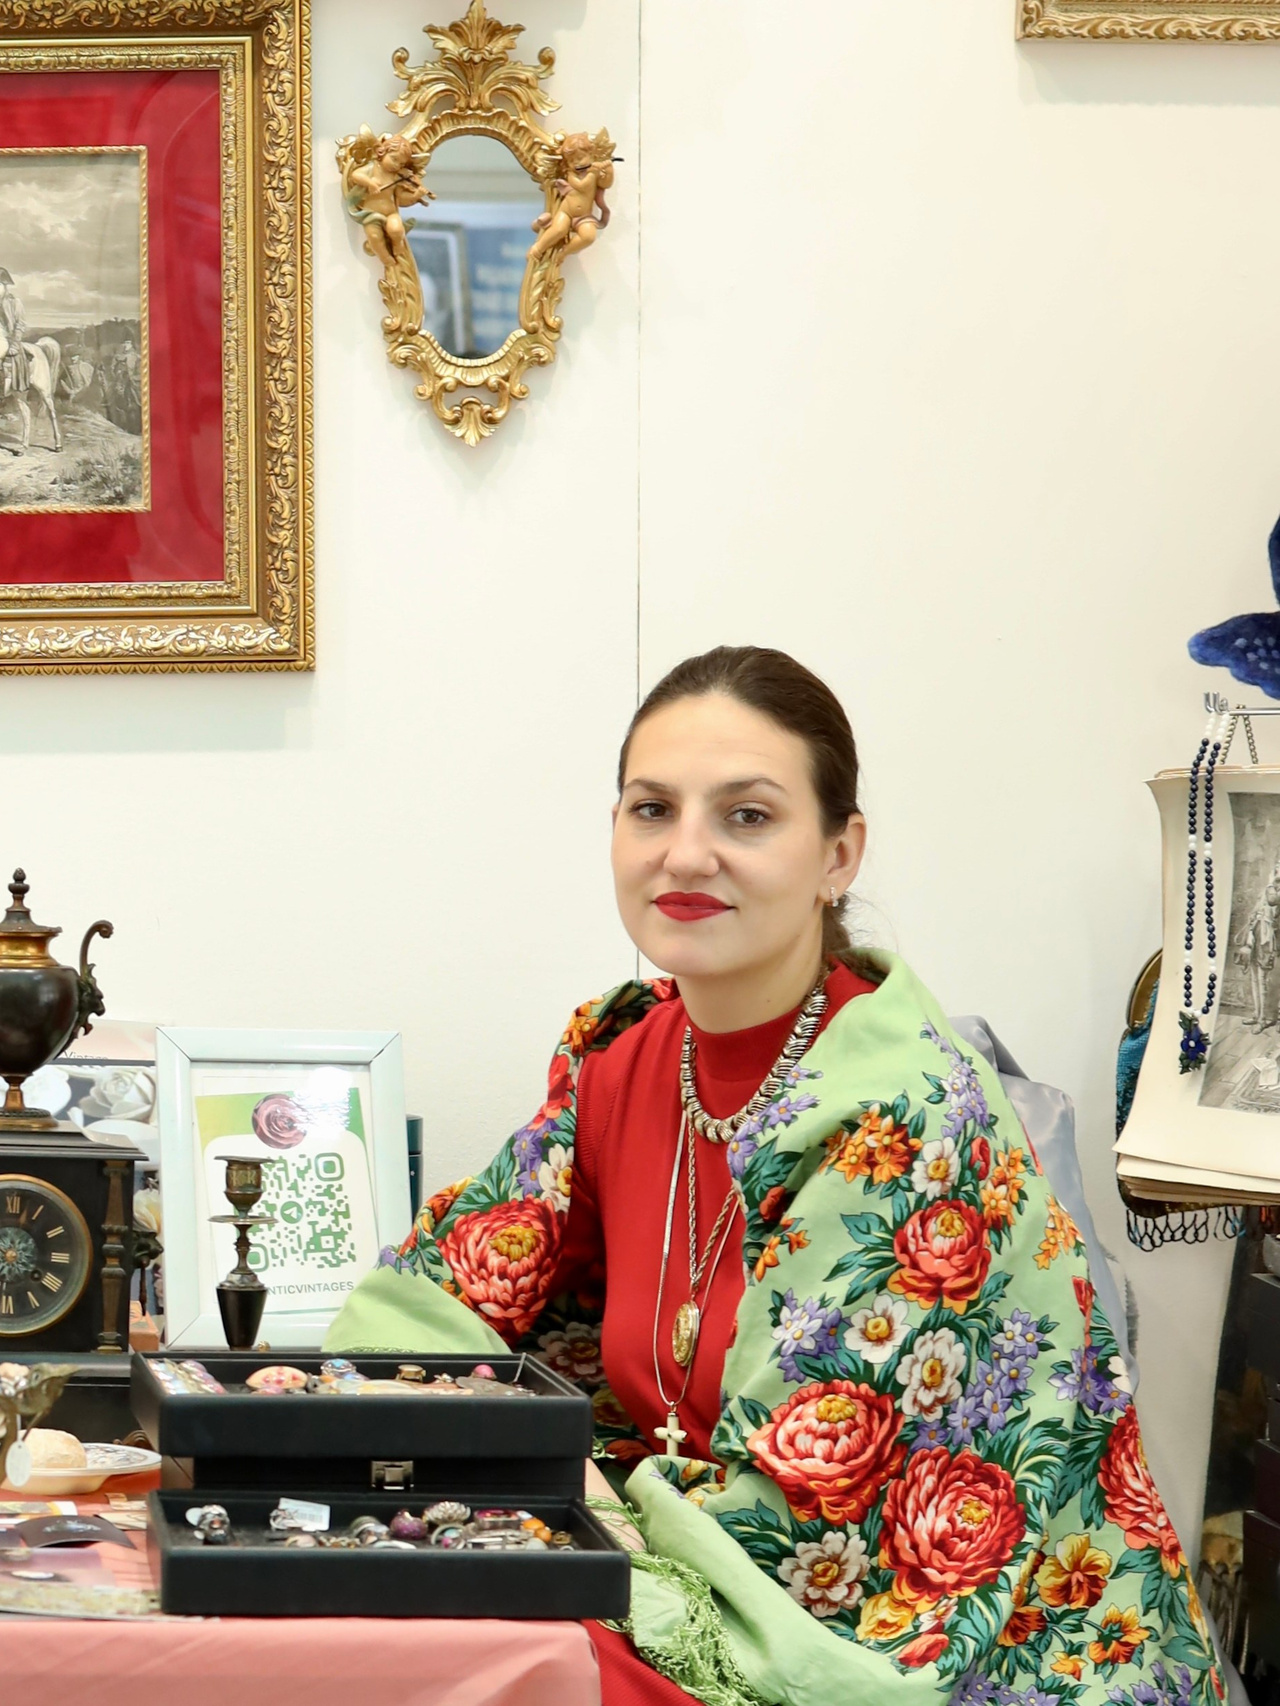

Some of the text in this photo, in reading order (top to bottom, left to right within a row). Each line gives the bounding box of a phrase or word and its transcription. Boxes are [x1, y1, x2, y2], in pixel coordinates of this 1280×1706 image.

[6, 1196, 21, 1214] XII
[46, 1226, 65, 1238] II
[51, 1252, 70, 1264] III
[268, 1281, 354, 1295] NTICVINTAGES
